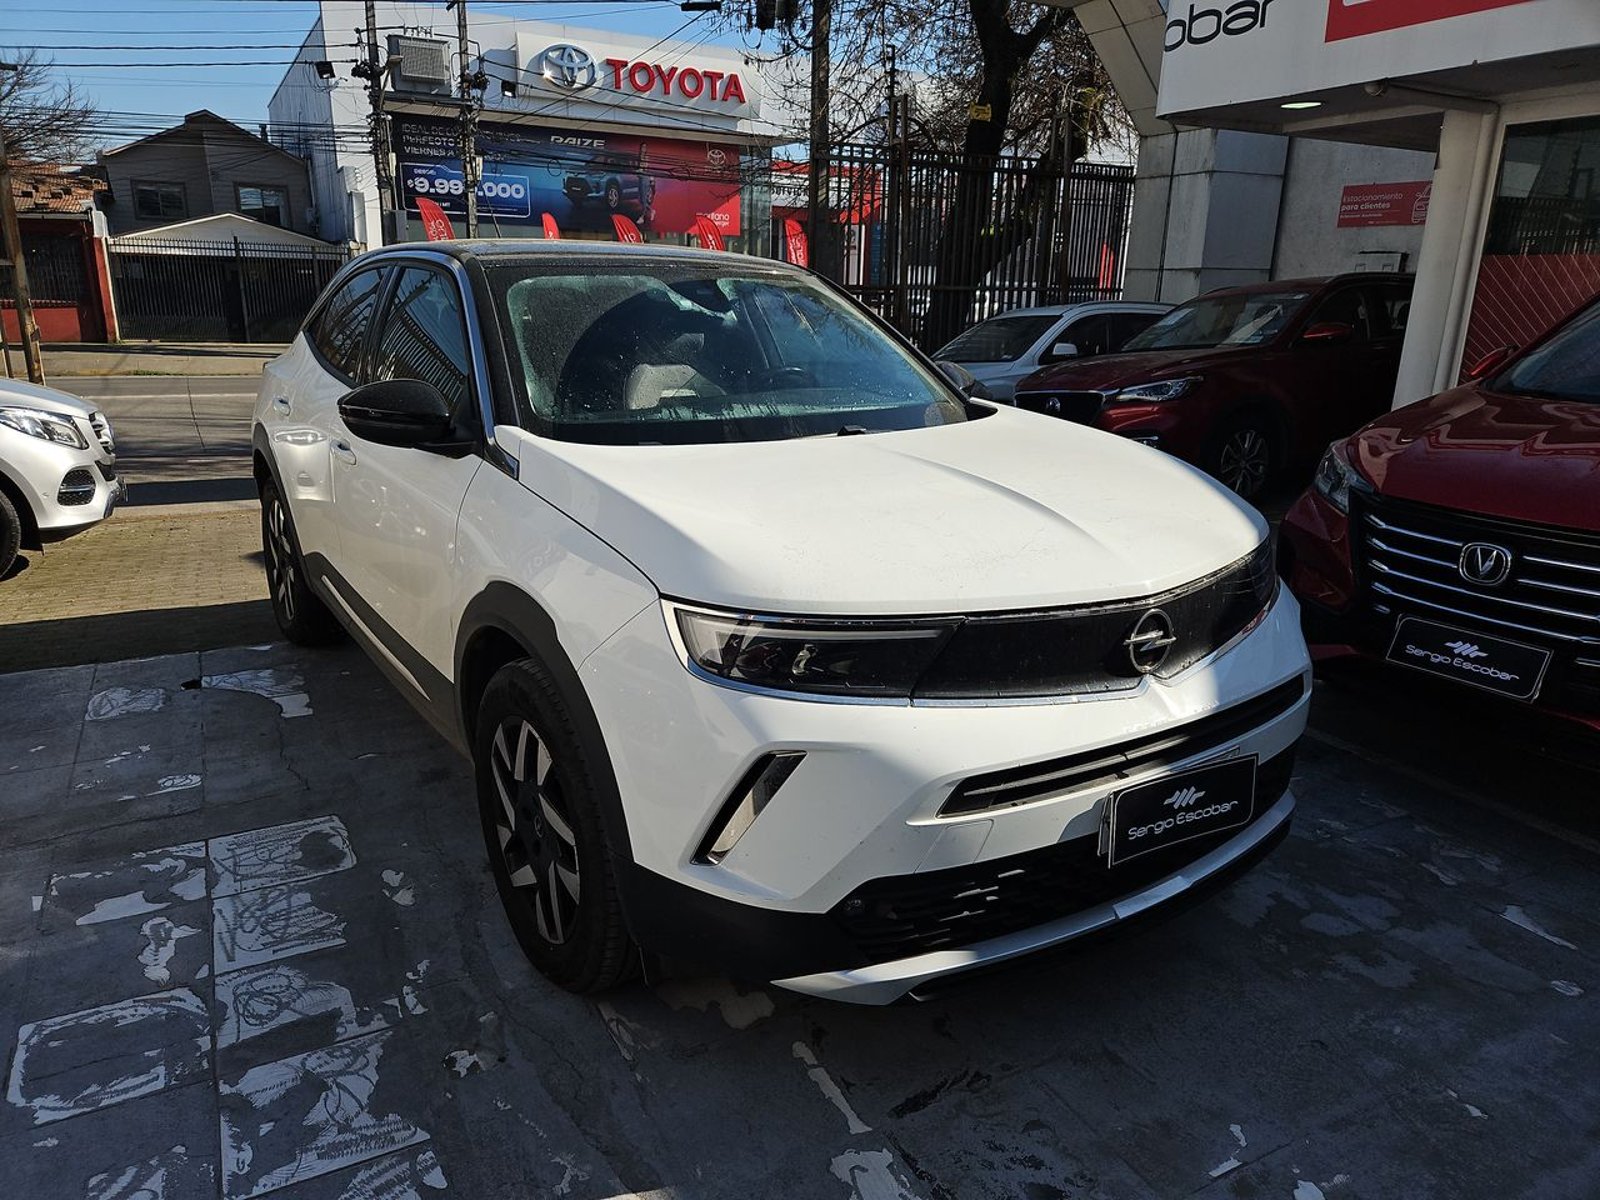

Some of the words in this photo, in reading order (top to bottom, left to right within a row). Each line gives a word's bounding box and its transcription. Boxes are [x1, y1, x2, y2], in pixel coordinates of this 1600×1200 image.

[606, 58, 746, 104] TOYOTA
[550, 135, 605, 149] RAIZE
[1452, 656, 1520, 681] Escobar
[1175, 800, 1239, 825] Escobar
